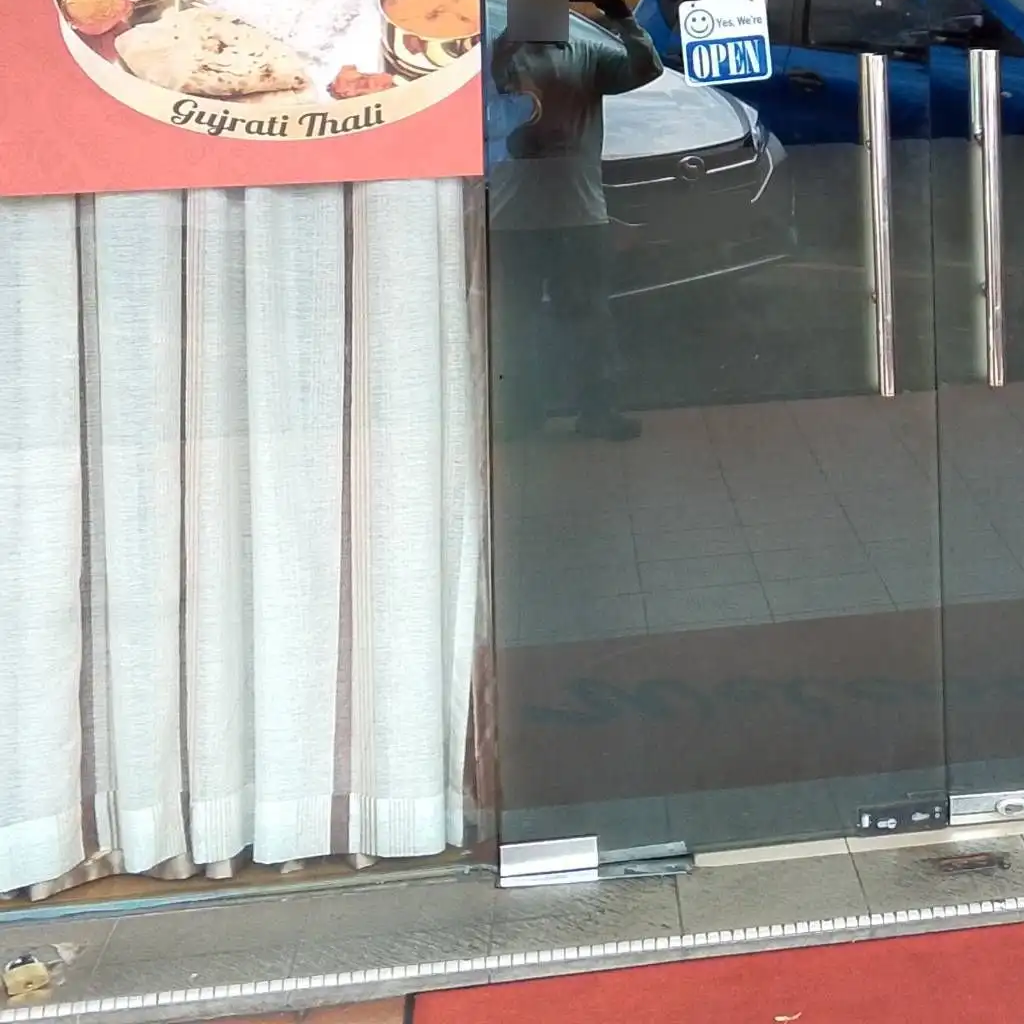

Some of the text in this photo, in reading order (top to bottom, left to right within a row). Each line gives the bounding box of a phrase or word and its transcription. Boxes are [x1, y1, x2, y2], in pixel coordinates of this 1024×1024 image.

[736, 15, 763, 26] We're
[692, 39, 761, 80] OPEN
[170, 99, 385, 138] Gujrati Thali
